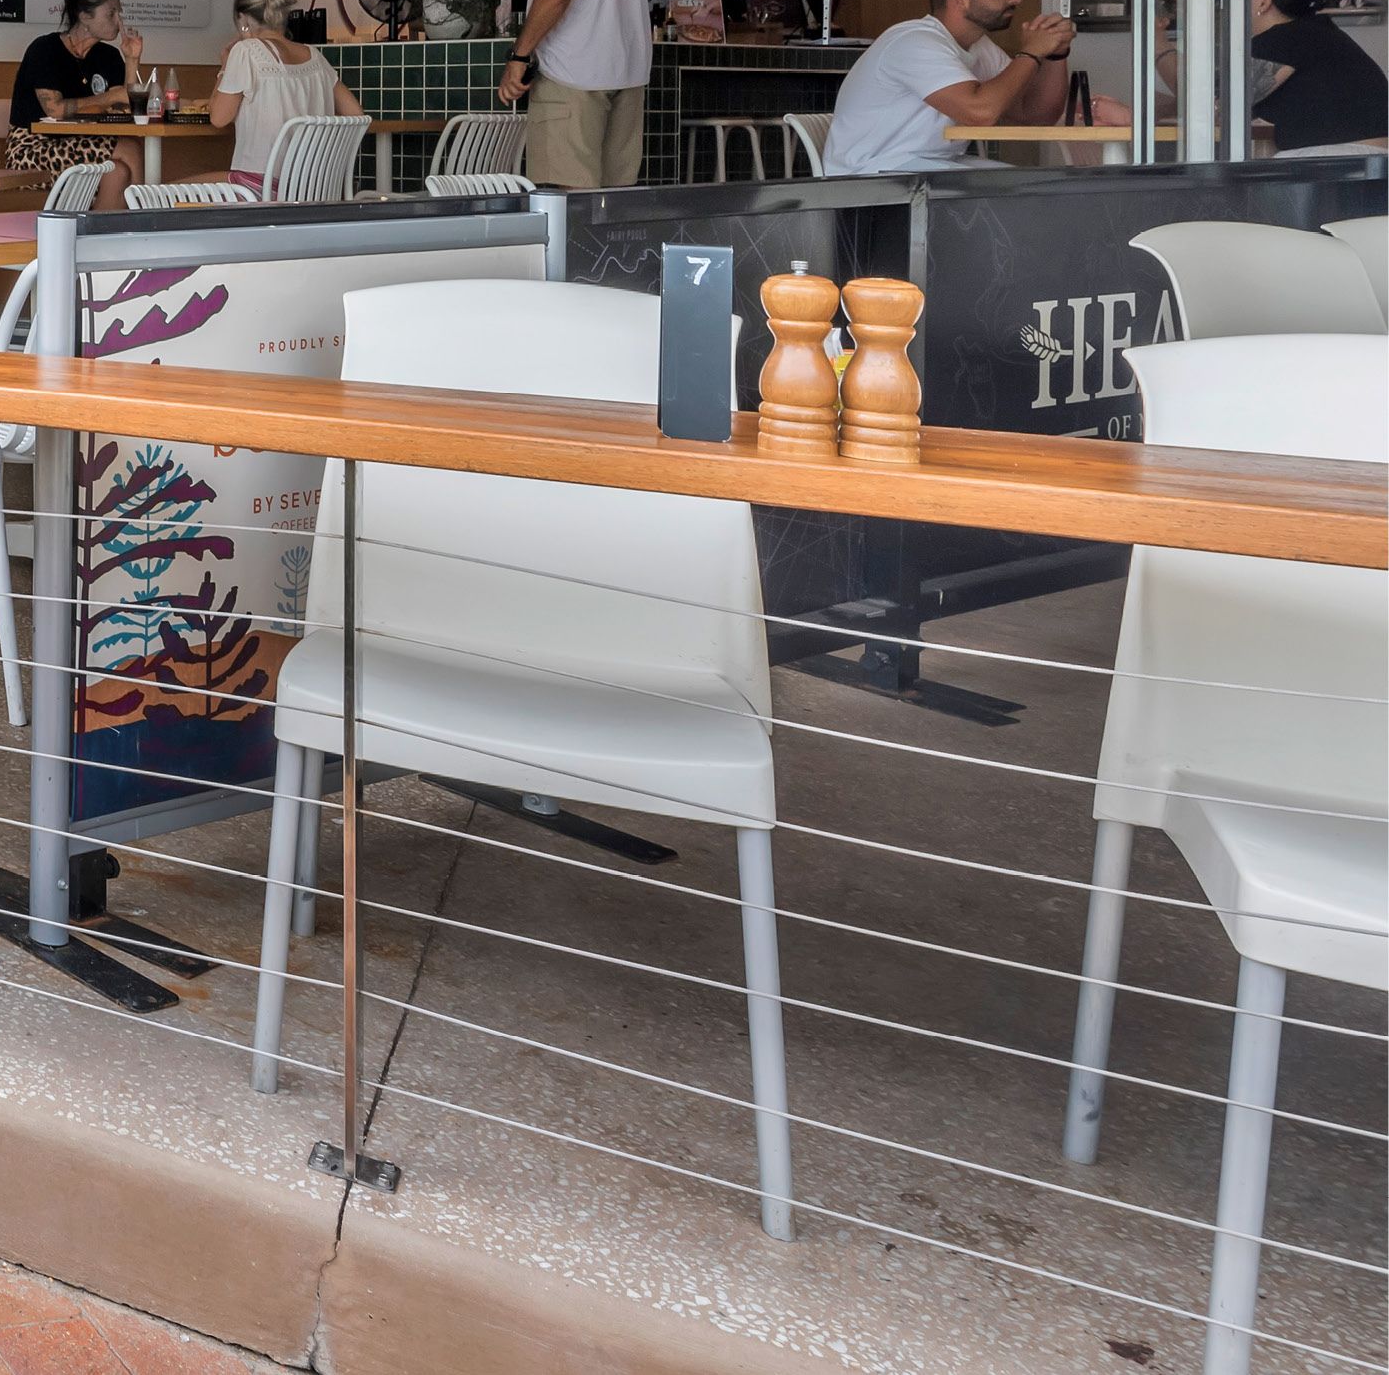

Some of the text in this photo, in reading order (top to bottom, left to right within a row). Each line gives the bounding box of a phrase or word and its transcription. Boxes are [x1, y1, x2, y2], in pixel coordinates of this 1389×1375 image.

[606, 228, 647, 241] FAIRY POOLS
[686, 256, 712, 286] 7
[259, 337, 325, 354] PROUDLY
[1107, 414, 1131, 441] OF
[253, 489, 321, 514] BY SEVE
